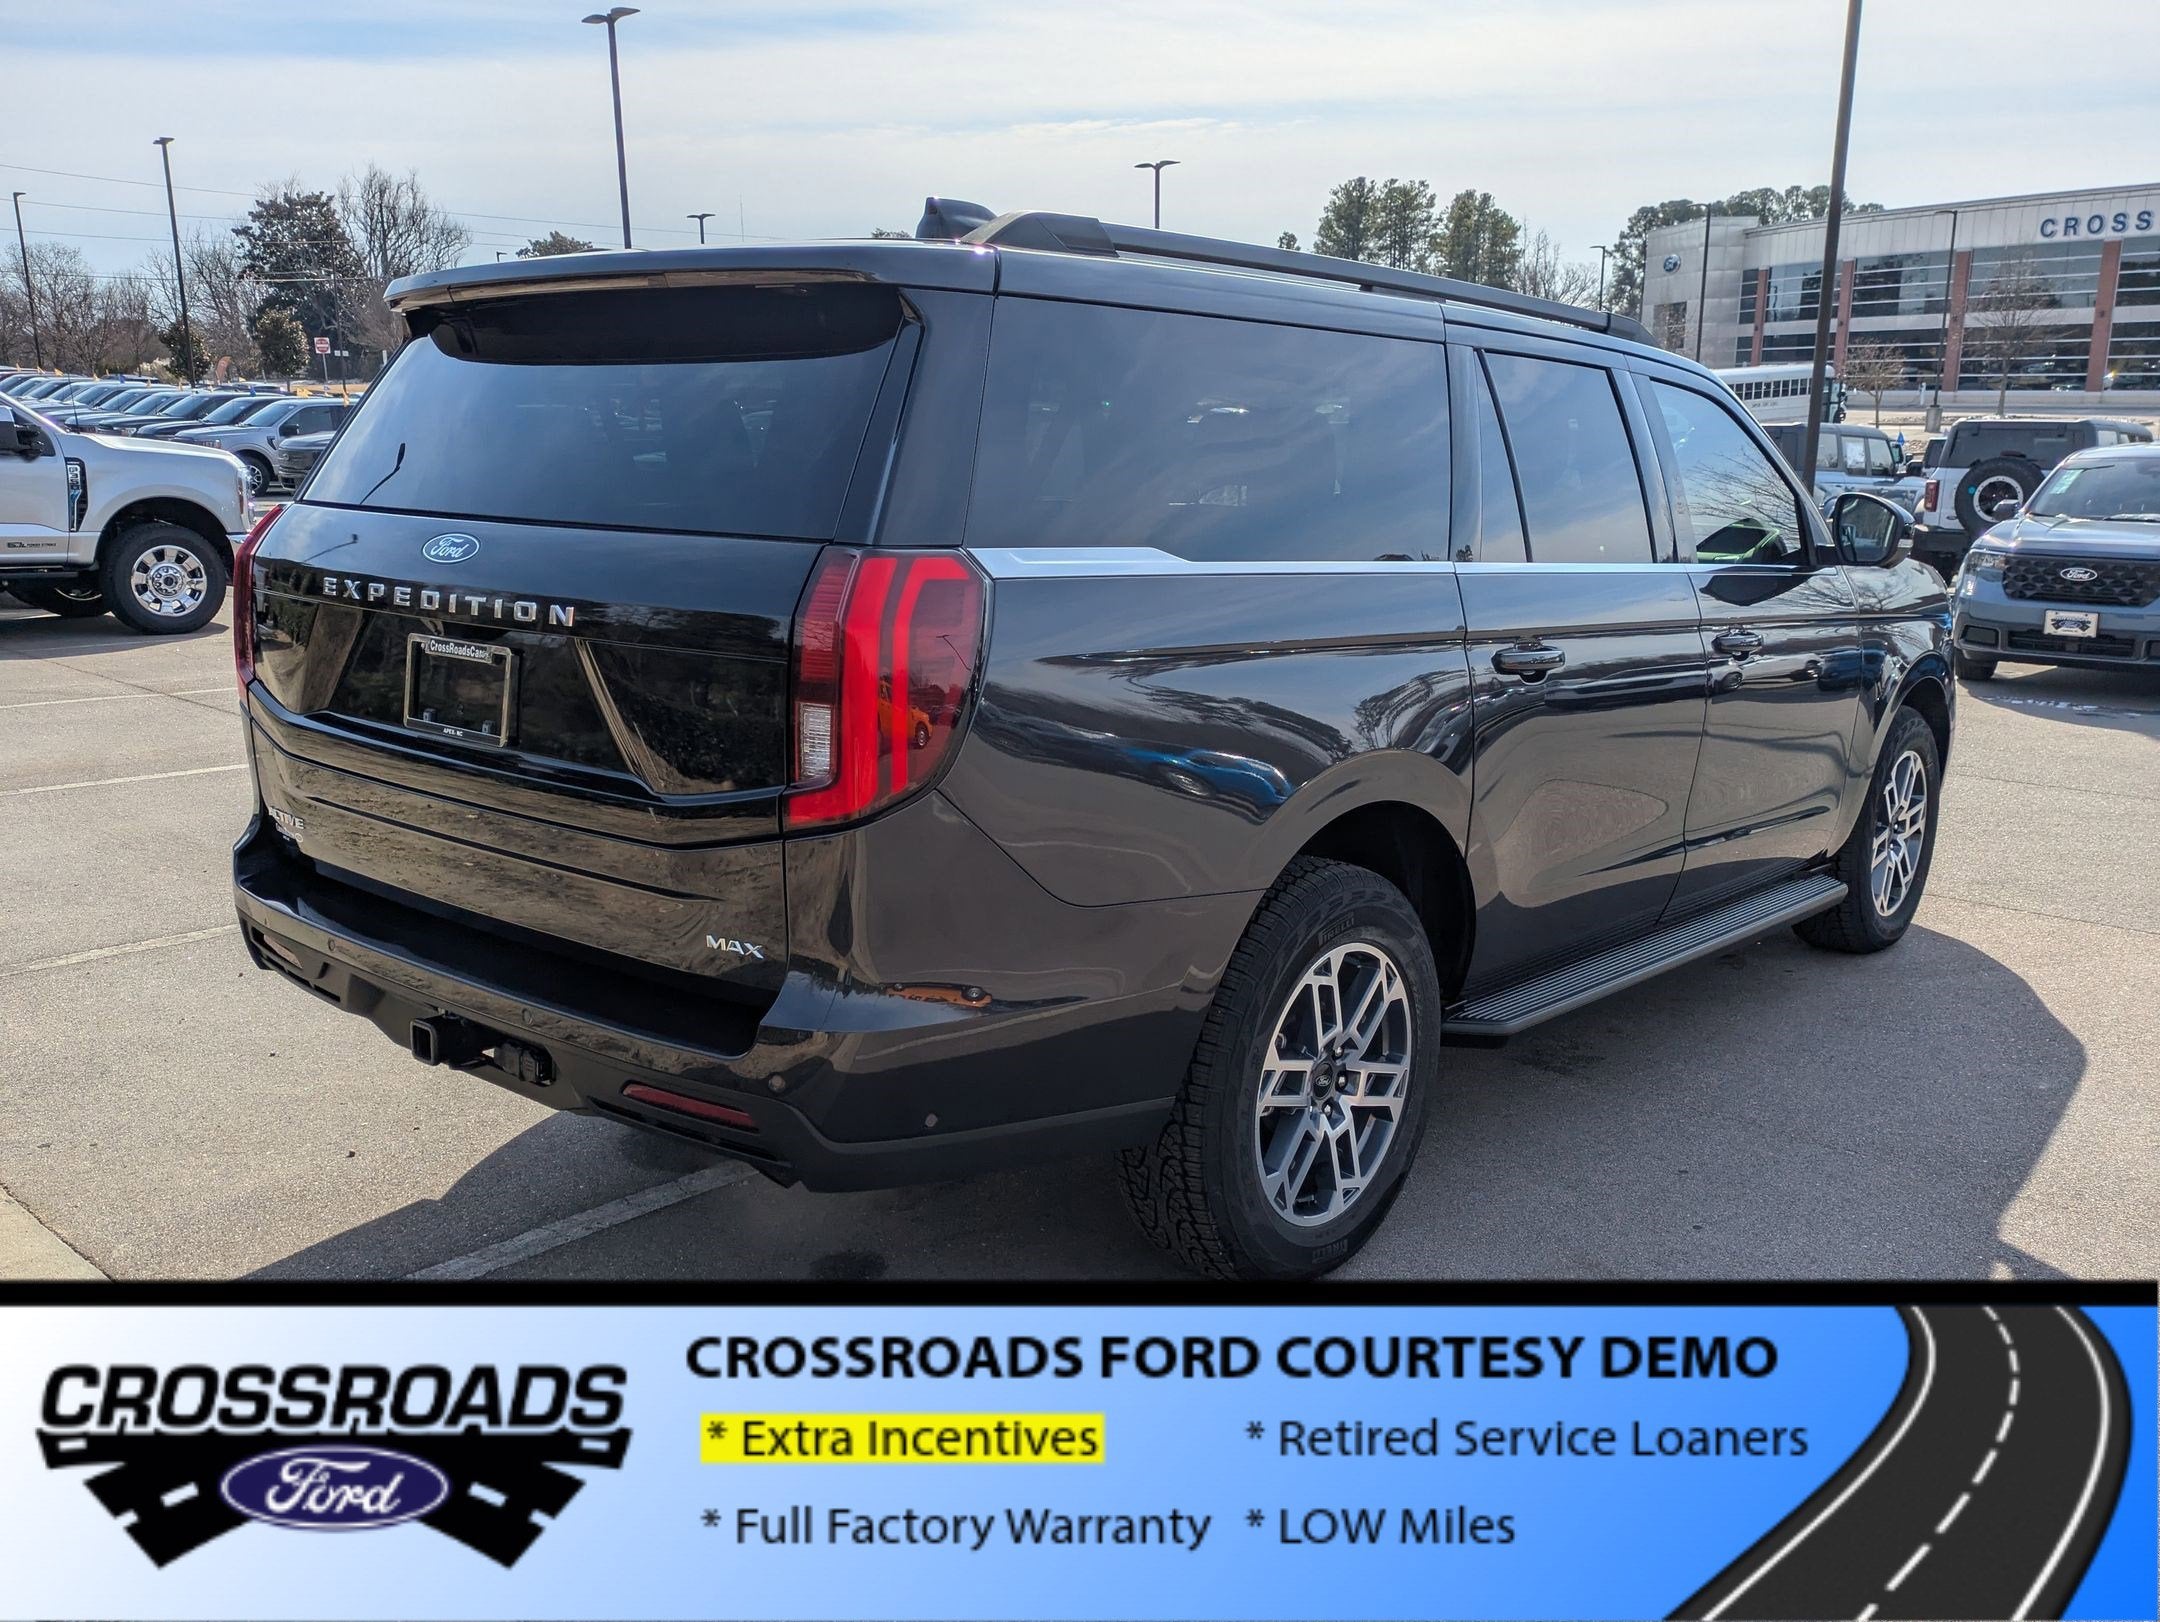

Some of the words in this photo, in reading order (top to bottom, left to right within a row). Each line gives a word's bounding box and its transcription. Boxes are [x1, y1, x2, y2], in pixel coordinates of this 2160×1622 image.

[2040, 210, 2153, 238] CROSS
[430, 537, 469, 558] Ford
[323, 576, 576, 627] EXPEDITION
[706, 935, 764, 959] MAX
